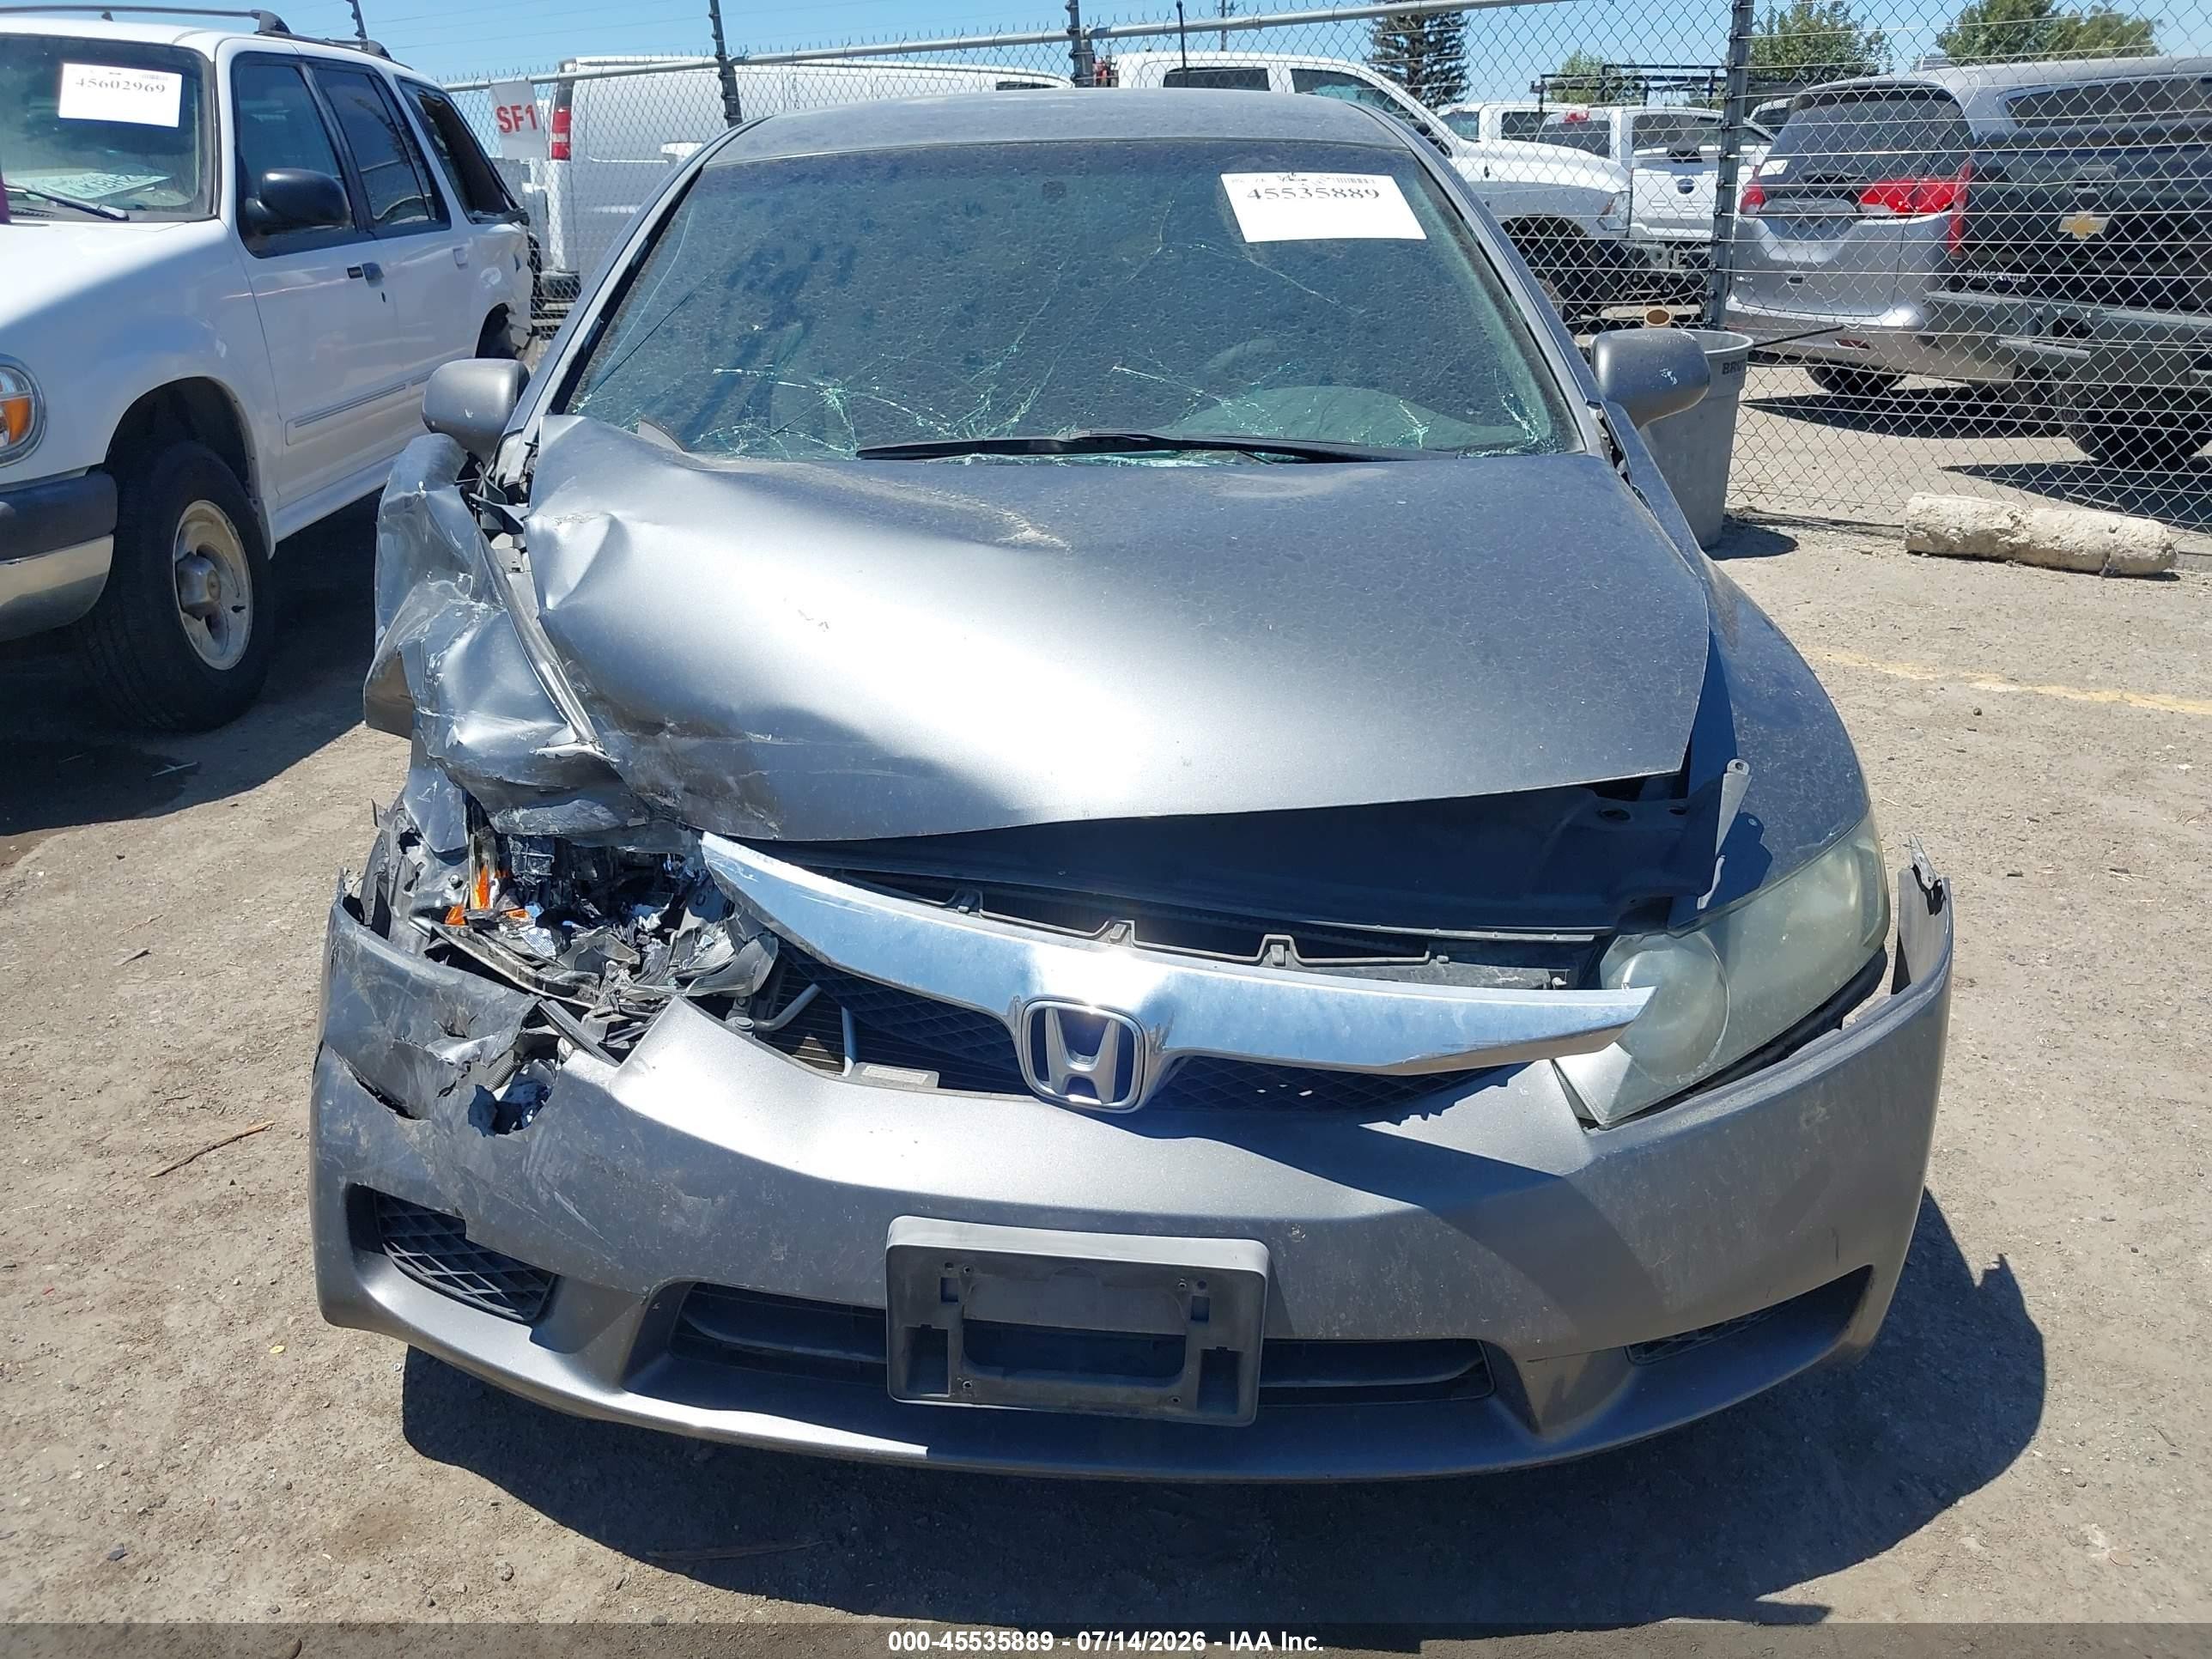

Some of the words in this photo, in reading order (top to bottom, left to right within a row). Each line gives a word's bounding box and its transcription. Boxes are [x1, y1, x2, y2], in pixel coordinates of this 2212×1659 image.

[75, 77, 166, 94] 45602969
[496, 104, 538, 133] SF1
[1246, 186, 1381, 201] 45535889
